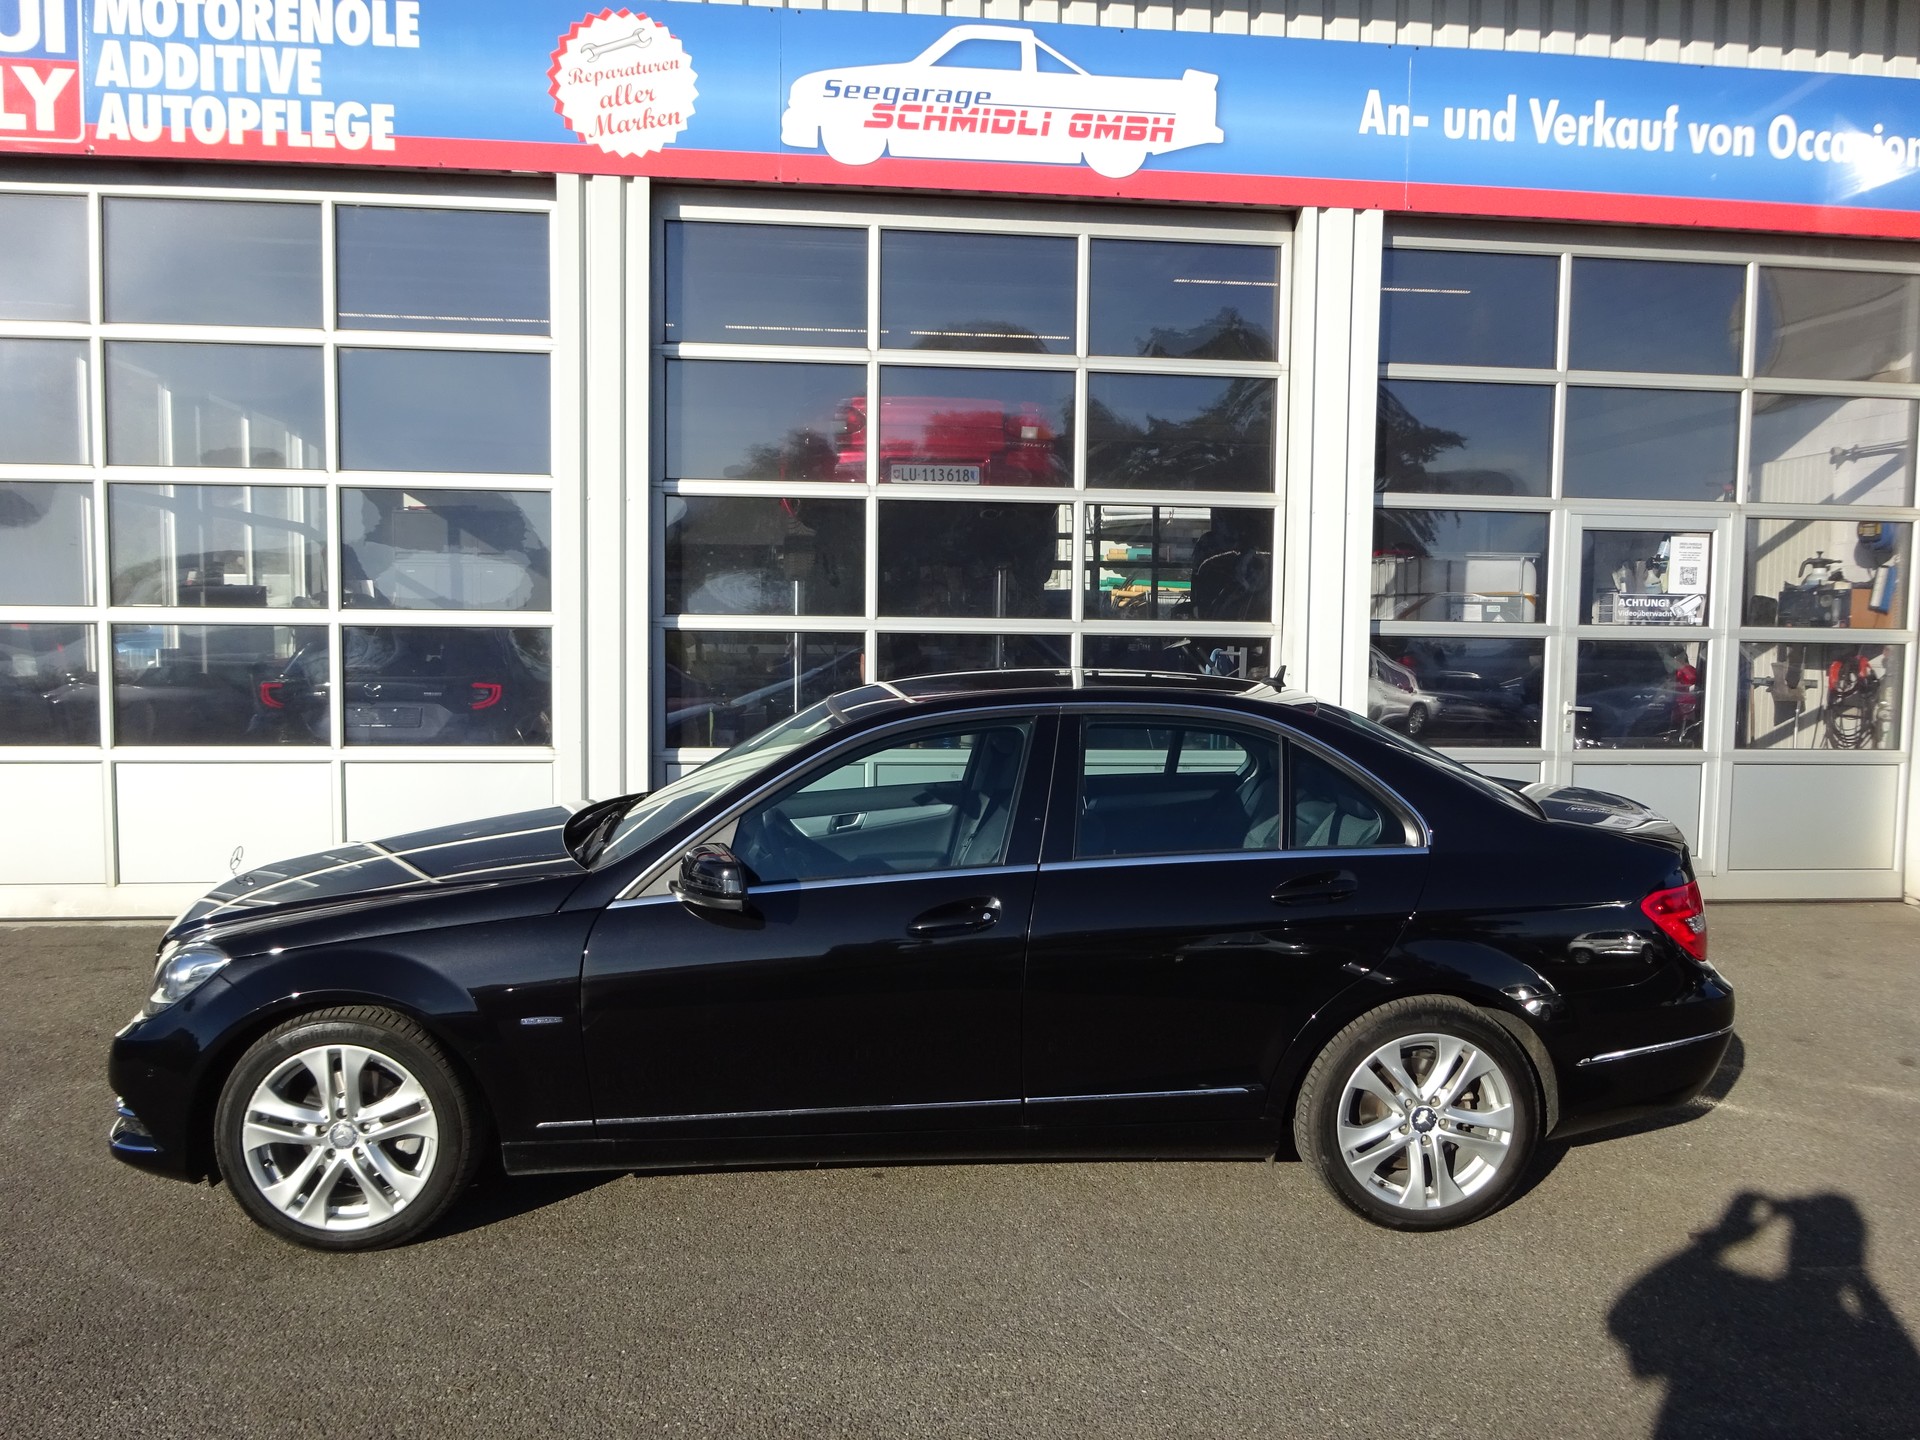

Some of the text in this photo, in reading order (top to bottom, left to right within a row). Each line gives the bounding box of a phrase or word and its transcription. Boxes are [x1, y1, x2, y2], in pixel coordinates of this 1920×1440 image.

[94, 39, 322, 96] ADDITIVE
[567, 59, 680, 87] Reparaturen
[599, 82, 657, 109] aller
[822, 79, 992, 109] Seegarage
[95, 92, 396, 151] AUTOPFLEGE
[588, 107, 682, 138] Marken
[863, 103, 1176, 143] SCHMIDLI GMBH
[1357, 89, 1920, 168] An- und Verkauf von Occaion
[1618, 598, 1670, 608] ACHTUNG!
